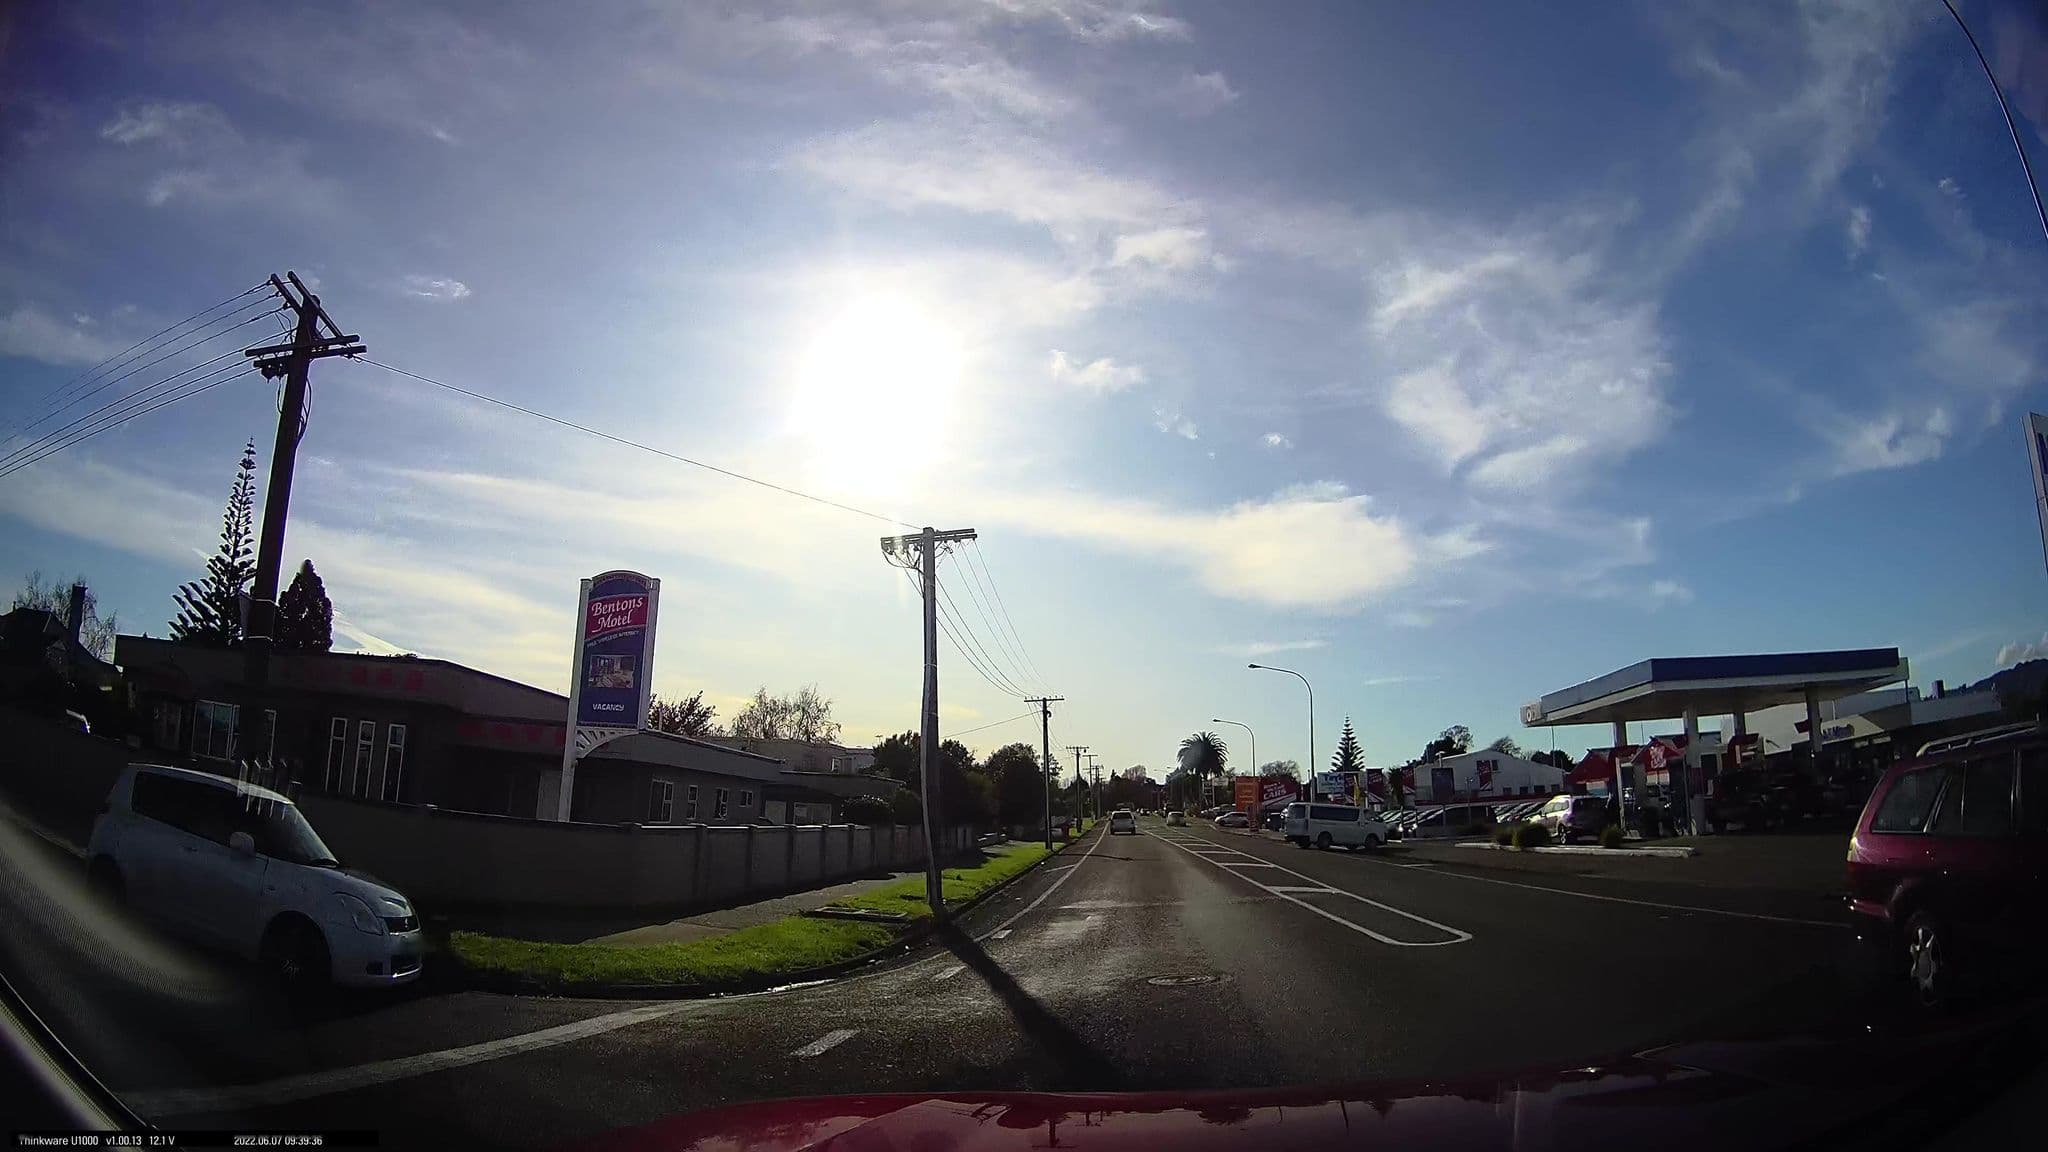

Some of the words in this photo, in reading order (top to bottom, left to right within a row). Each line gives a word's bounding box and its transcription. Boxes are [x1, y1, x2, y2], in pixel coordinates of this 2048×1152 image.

[591, 597, 644, 617] Bentons
[592, 609, 634, 633] Motel
[592, 703, 625, 712] VACANCY
